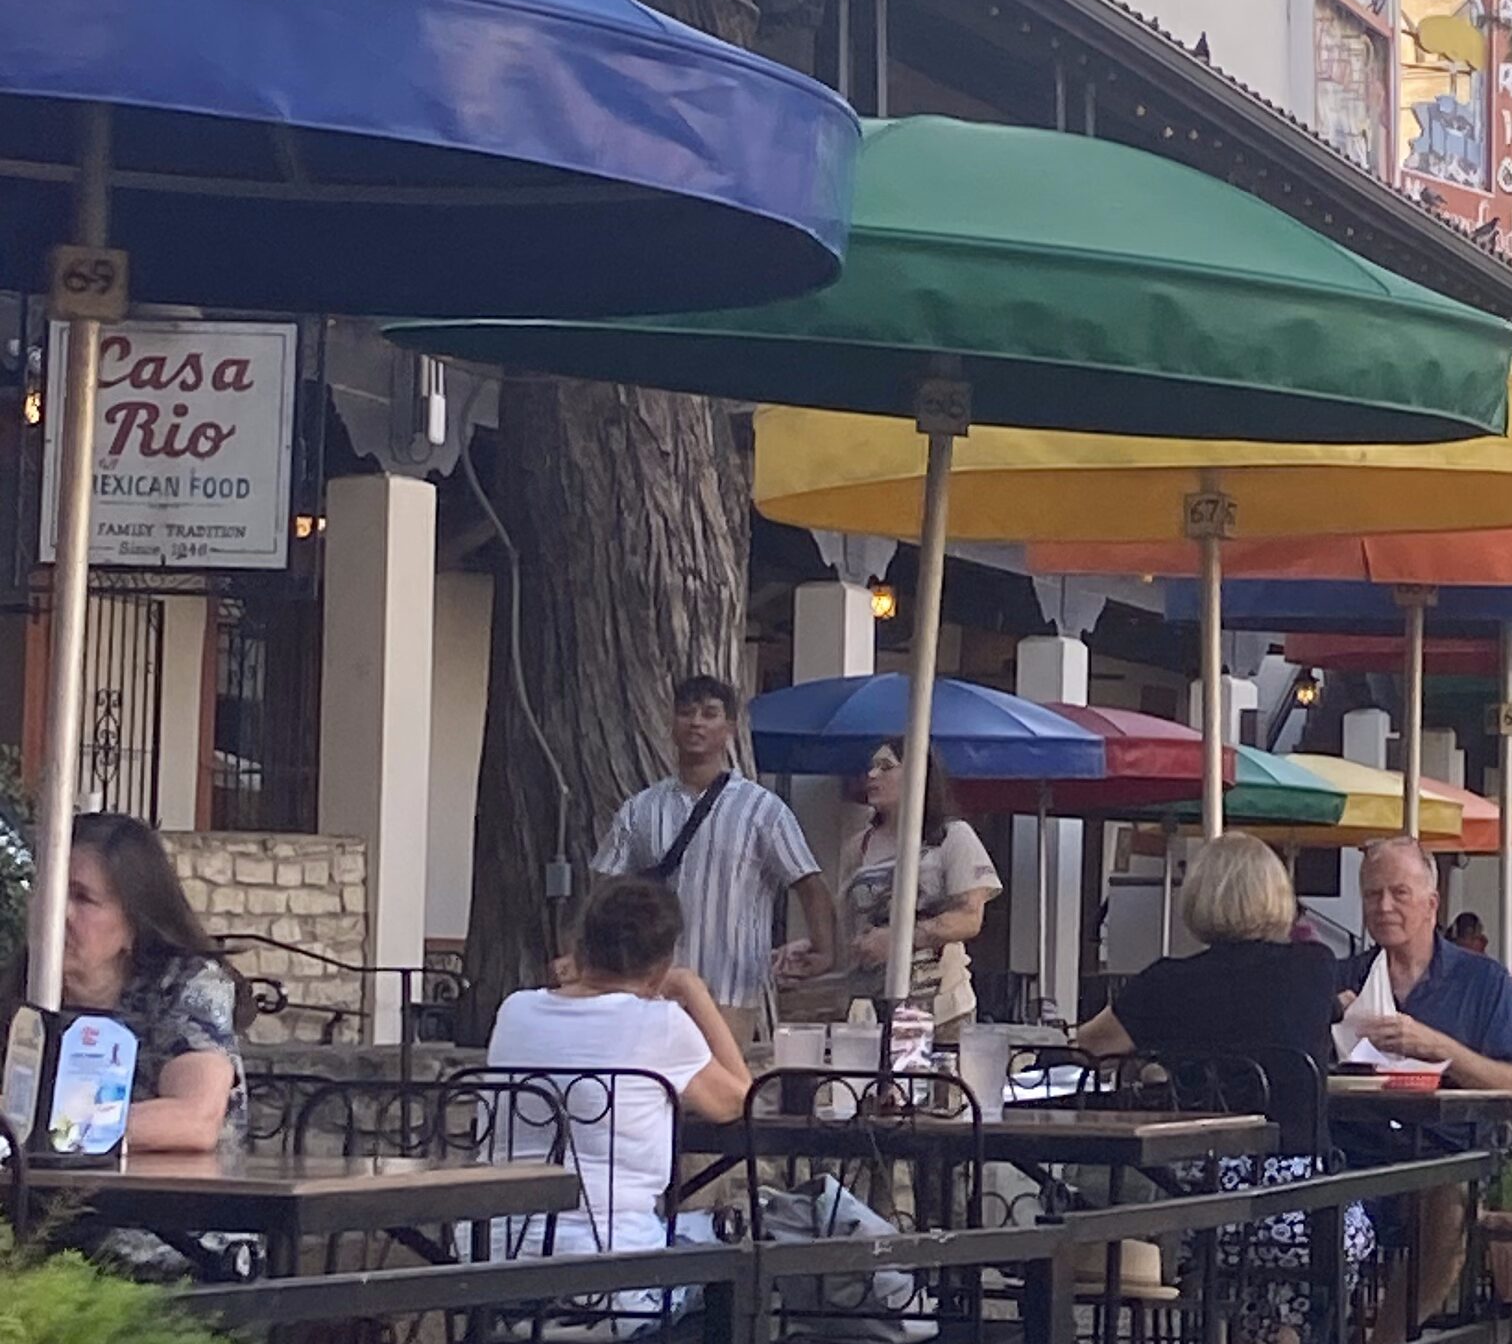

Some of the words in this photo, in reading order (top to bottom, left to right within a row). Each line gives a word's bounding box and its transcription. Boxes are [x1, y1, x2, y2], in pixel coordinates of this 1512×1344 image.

[97, 336, 254, 392] Casa
[105, 401, 236, 459] Rio
[92, 473, 179, 497] EXICAN
[190, 474, 250, 499] FOOD
[1190, 500, 1219, 523] 67
[97, 522, 155, 537] FAMILY
[166, 524, 247, 538] TRADITION
[118, 541, 160, 555] Since
